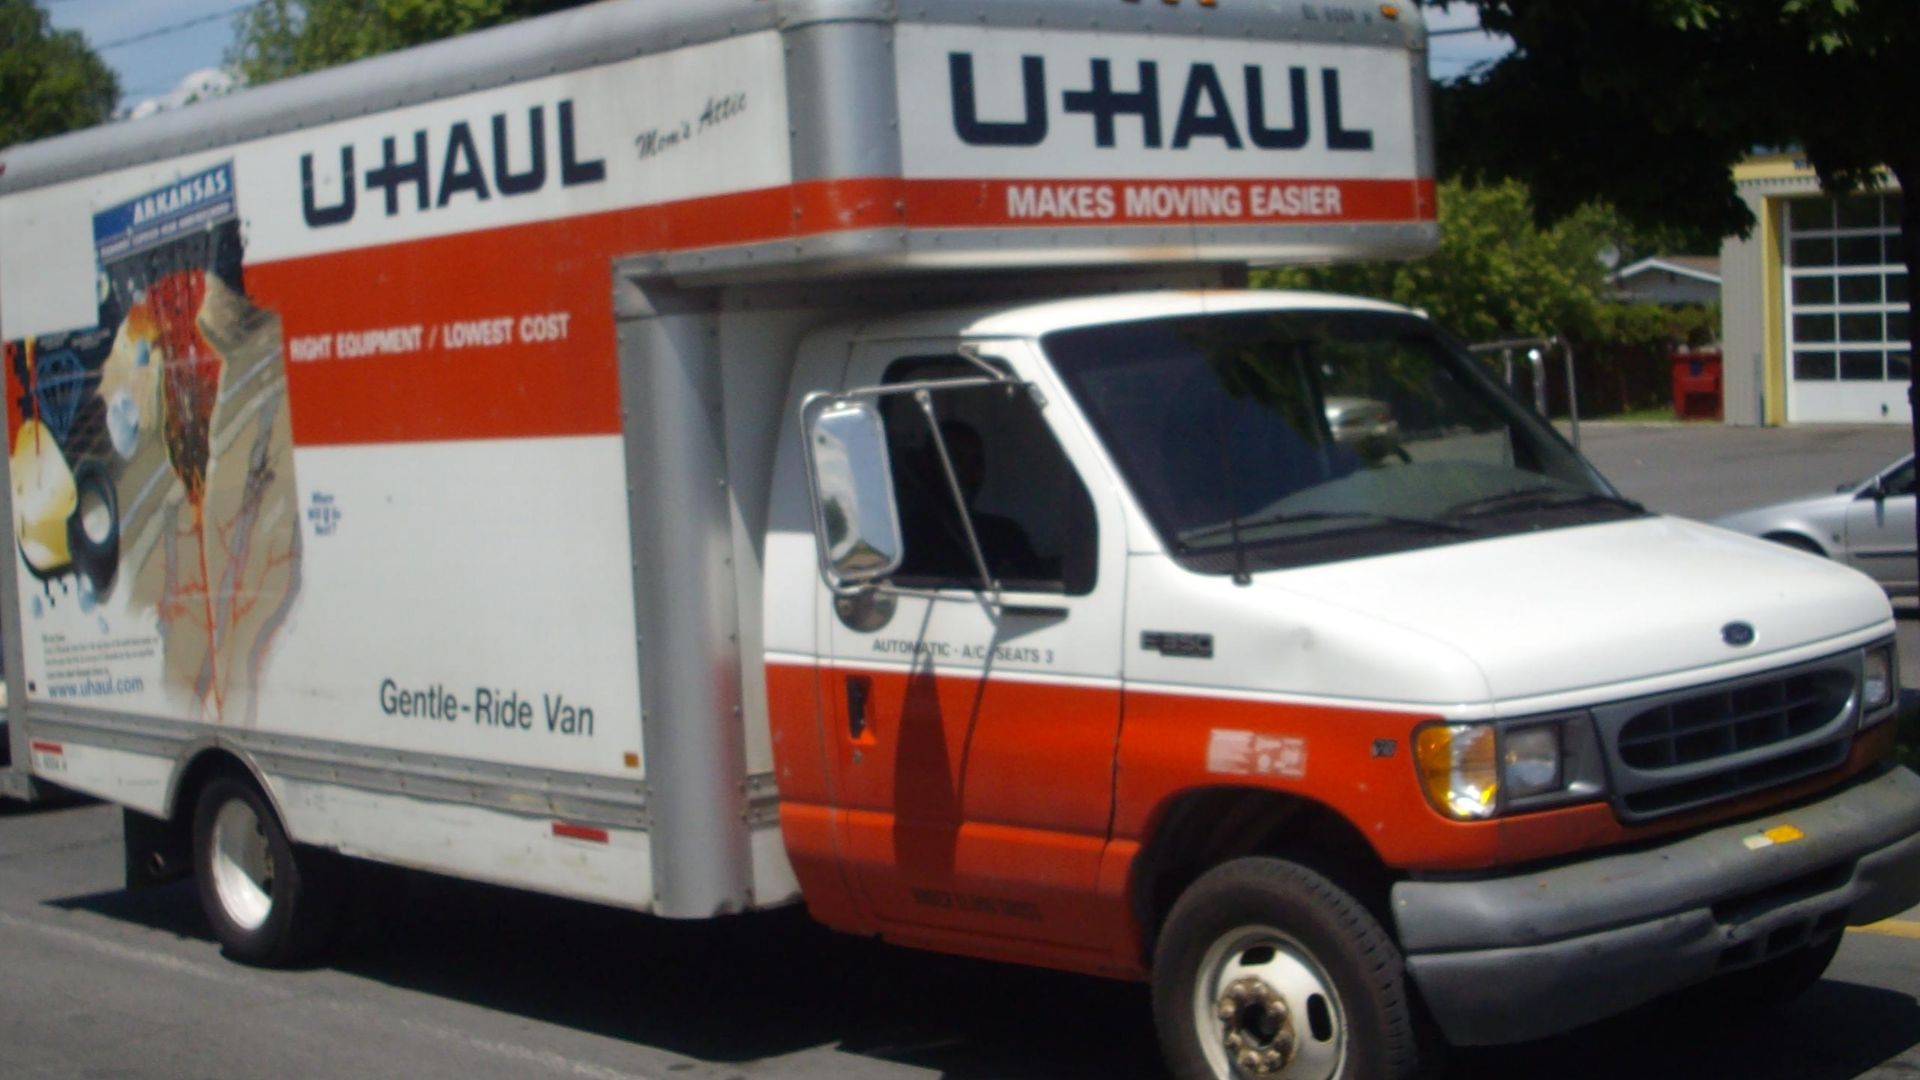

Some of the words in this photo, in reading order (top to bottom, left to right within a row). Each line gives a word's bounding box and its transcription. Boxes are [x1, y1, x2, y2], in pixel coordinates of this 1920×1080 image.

[634, 127, 691, 160] Mom's
[698, 92, 747, 136] Attic
[948, 52, 1374, 151] U-HAUL
[301, 99, 606, 228] U-HAUL
[133, 169, 227, 225] ARKANSAS
[1007, 185, 1115, 219] MAKES
[1124, 185, 1242, 219] MOVING
[1251, 185, 1342, 216] EASIER
[290, 335, 333, 362] RIGHT
[336, 324, 422, 359] EQUIPMENT
[443, 317, 515, 349] LOWEST
[519, 311, 570, 343] COST
[872, 638, 951, 657] AUTOMATIC
[961, 644, 985, 660] A/C
[998, 647, 1040, 663] SEATS
[1045, 650, 1055, 664] 3
[48, 675, 145, 698] www.uhaul.com
[379, 677, 533, 730] Gentle-Ride
[543, 692, 594, 737] Van
